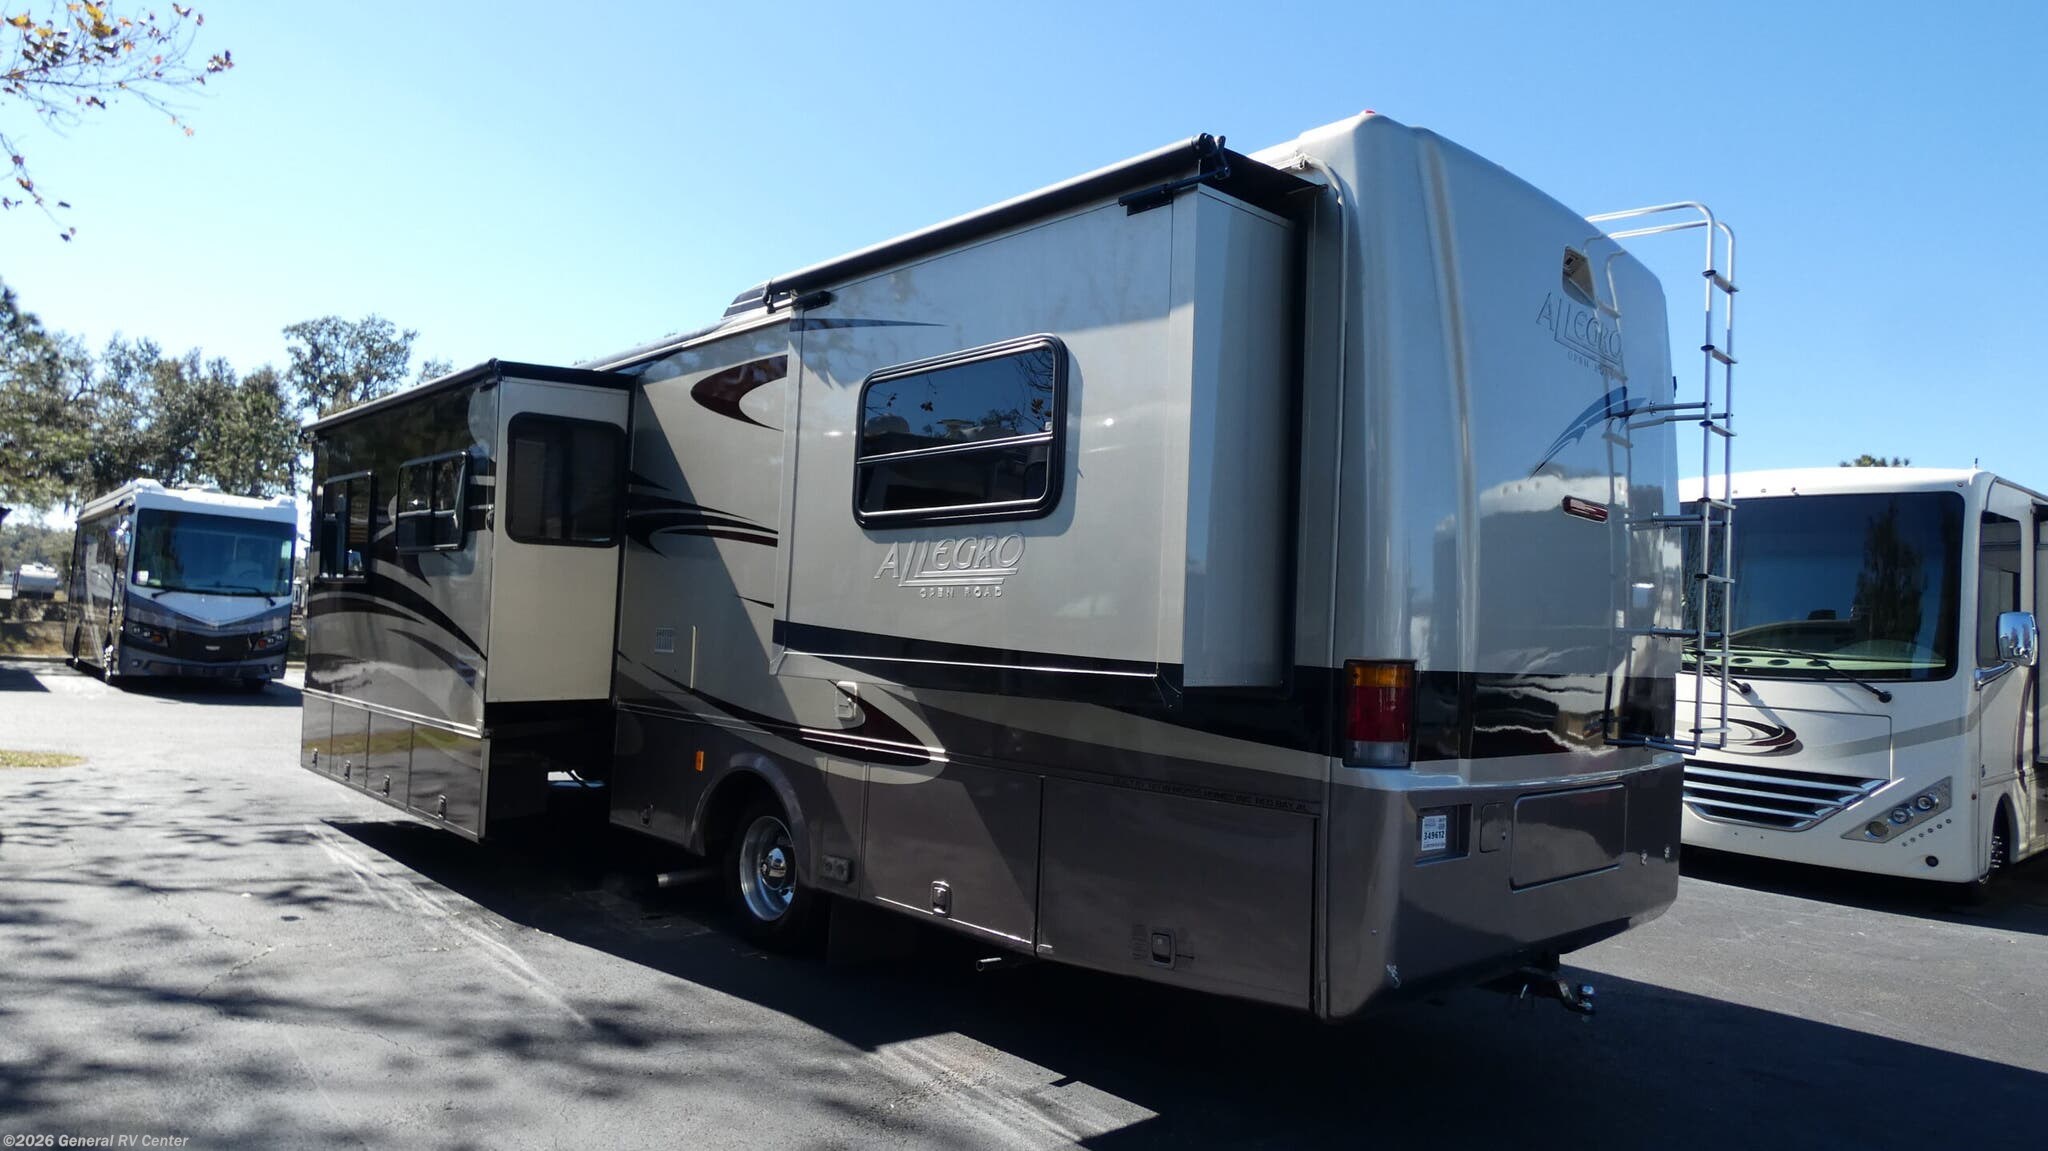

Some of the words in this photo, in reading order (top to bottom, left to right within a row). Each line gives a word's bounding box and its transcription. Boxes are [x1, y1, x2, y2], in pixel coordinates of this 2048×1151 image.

[1536, 292, 1621, 364] ALLEGRO
[873, 531, 1026, 587] ALLEGRO
[919, 586, 955, 599] OPEN
[963, 585, 1003, 599] ROAD
